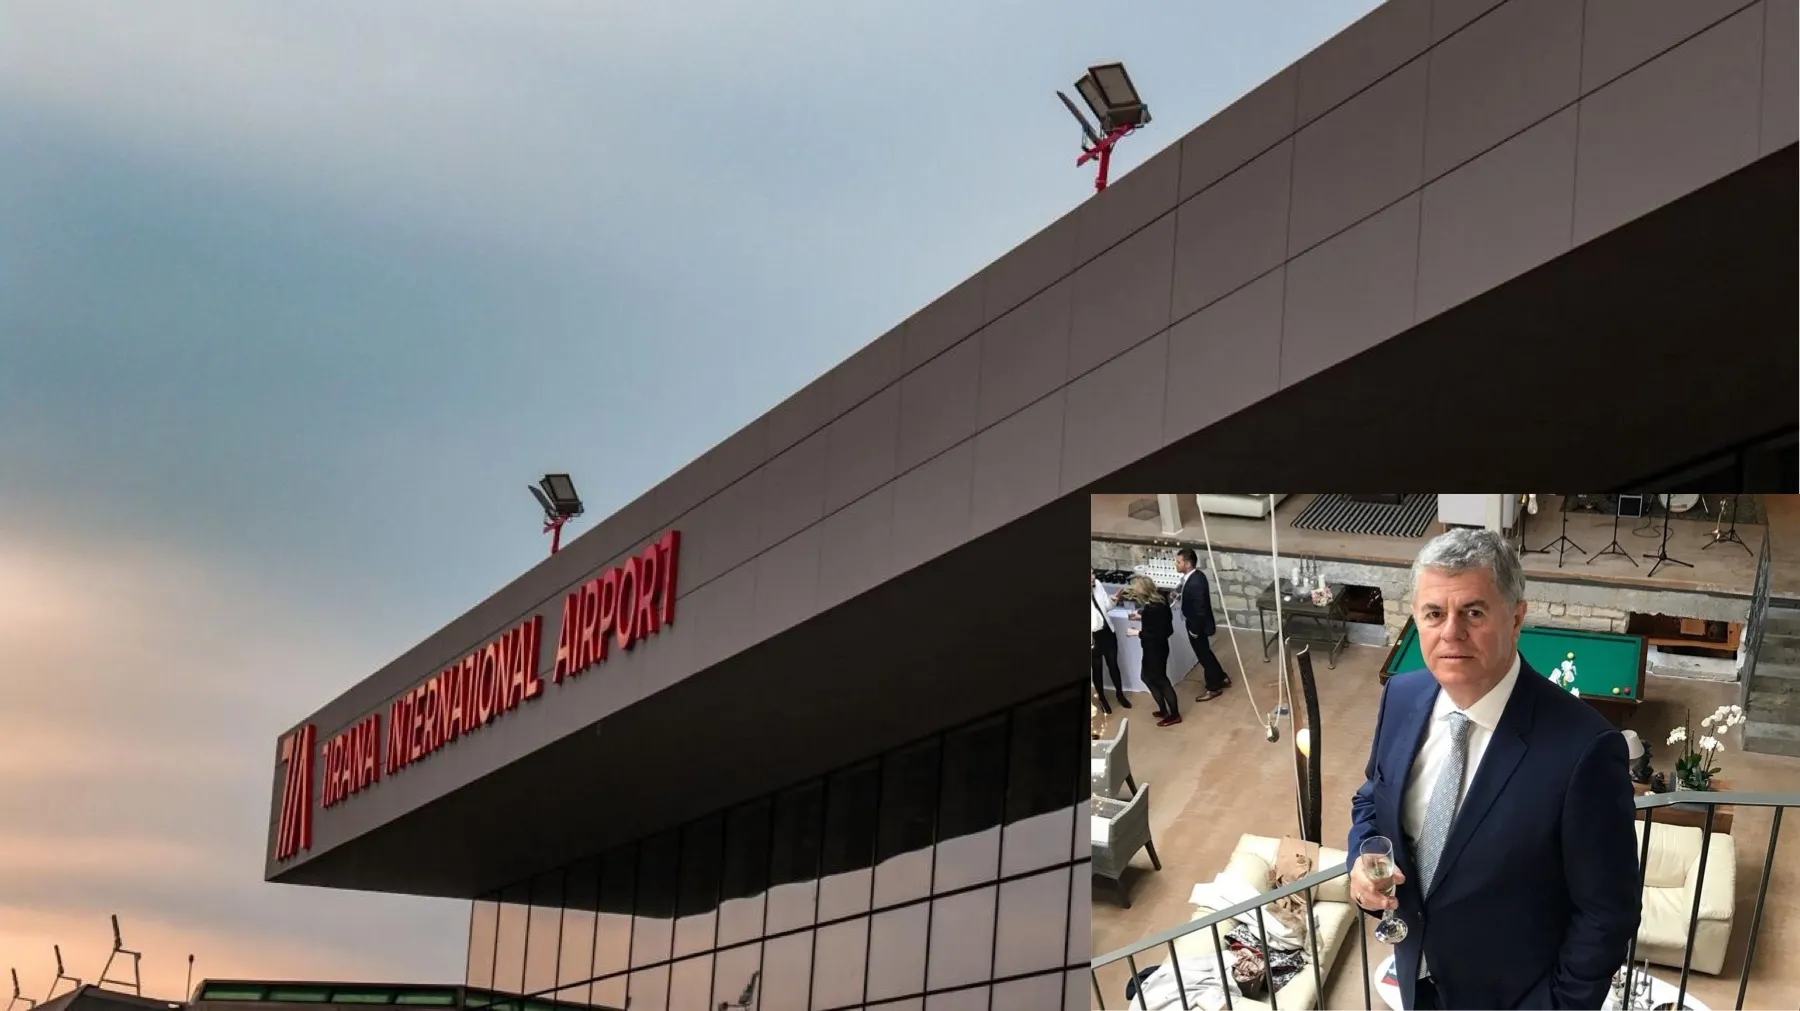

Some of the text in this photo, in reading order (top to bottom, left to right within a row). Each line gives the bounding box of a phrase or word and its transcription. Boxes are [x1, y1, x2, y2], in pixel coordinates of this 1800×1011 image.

[321, 530, 681, 808] TIRANA INTERNATIONAL AIRPORT
